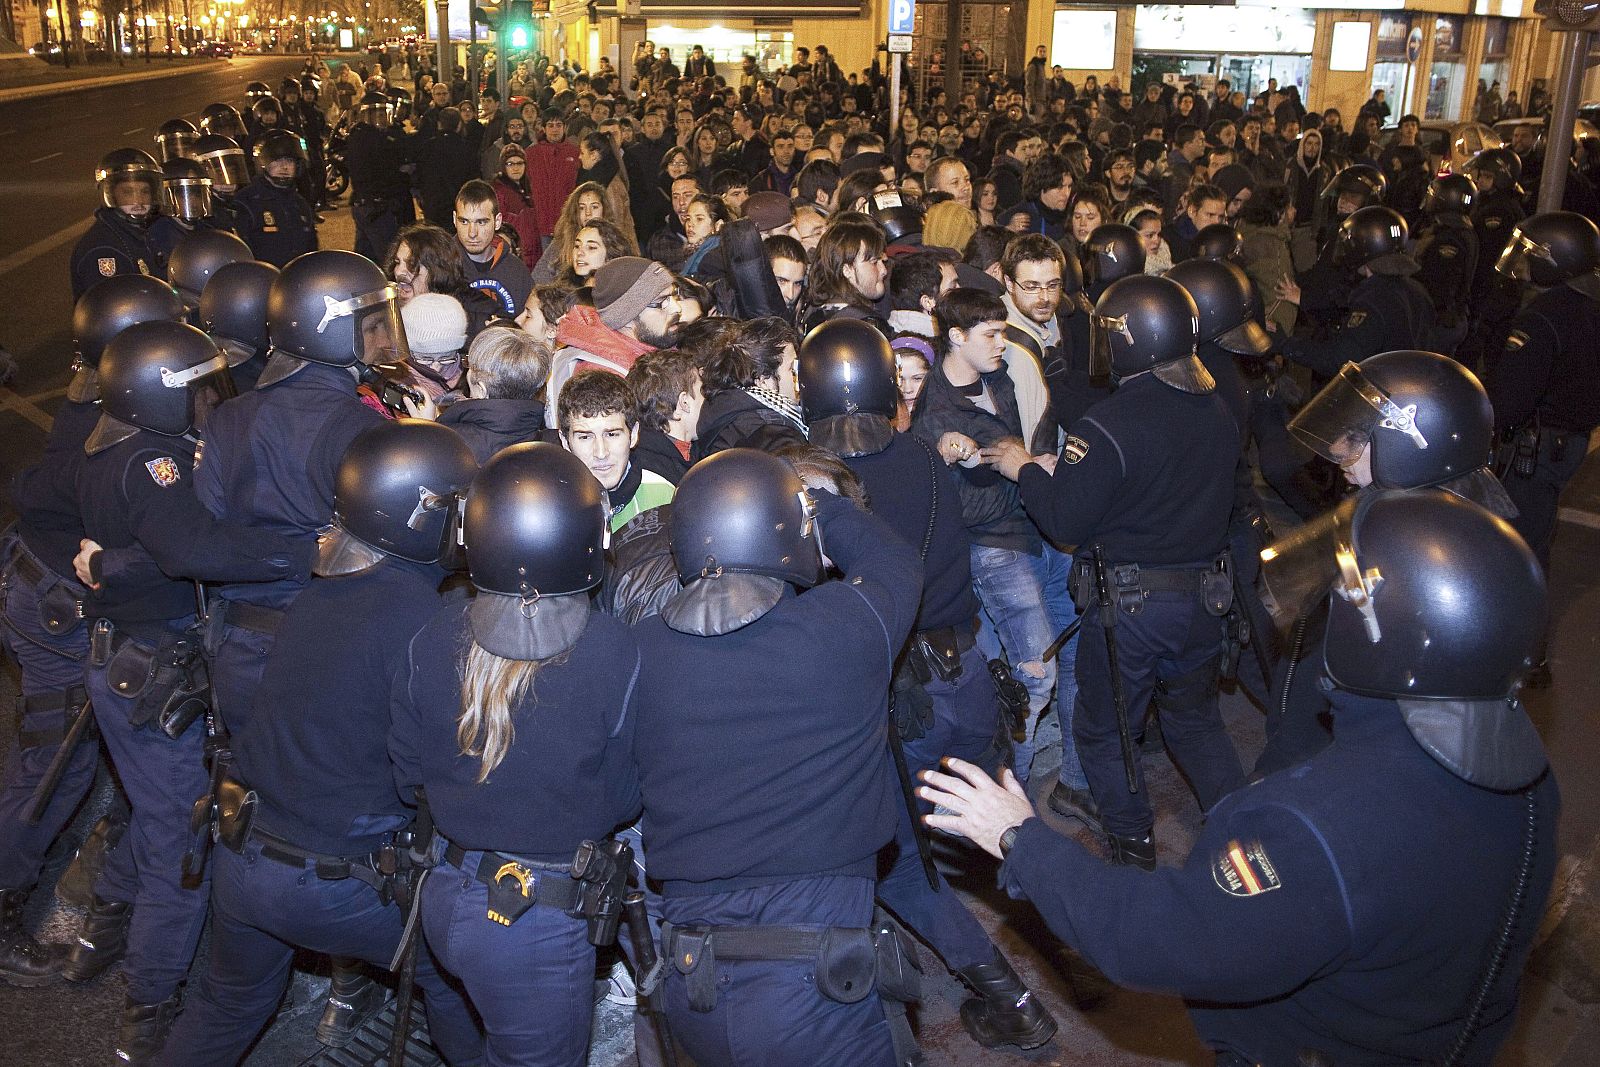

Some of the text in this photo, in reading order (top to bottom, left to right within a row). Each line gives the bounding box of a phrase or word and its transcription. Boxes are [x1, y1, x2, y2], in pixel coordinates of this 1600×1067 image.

[893, 0, 910, 30] P
[479, 279, 497, 287] BASE
[498, 287, 515, 309] ROGUE
